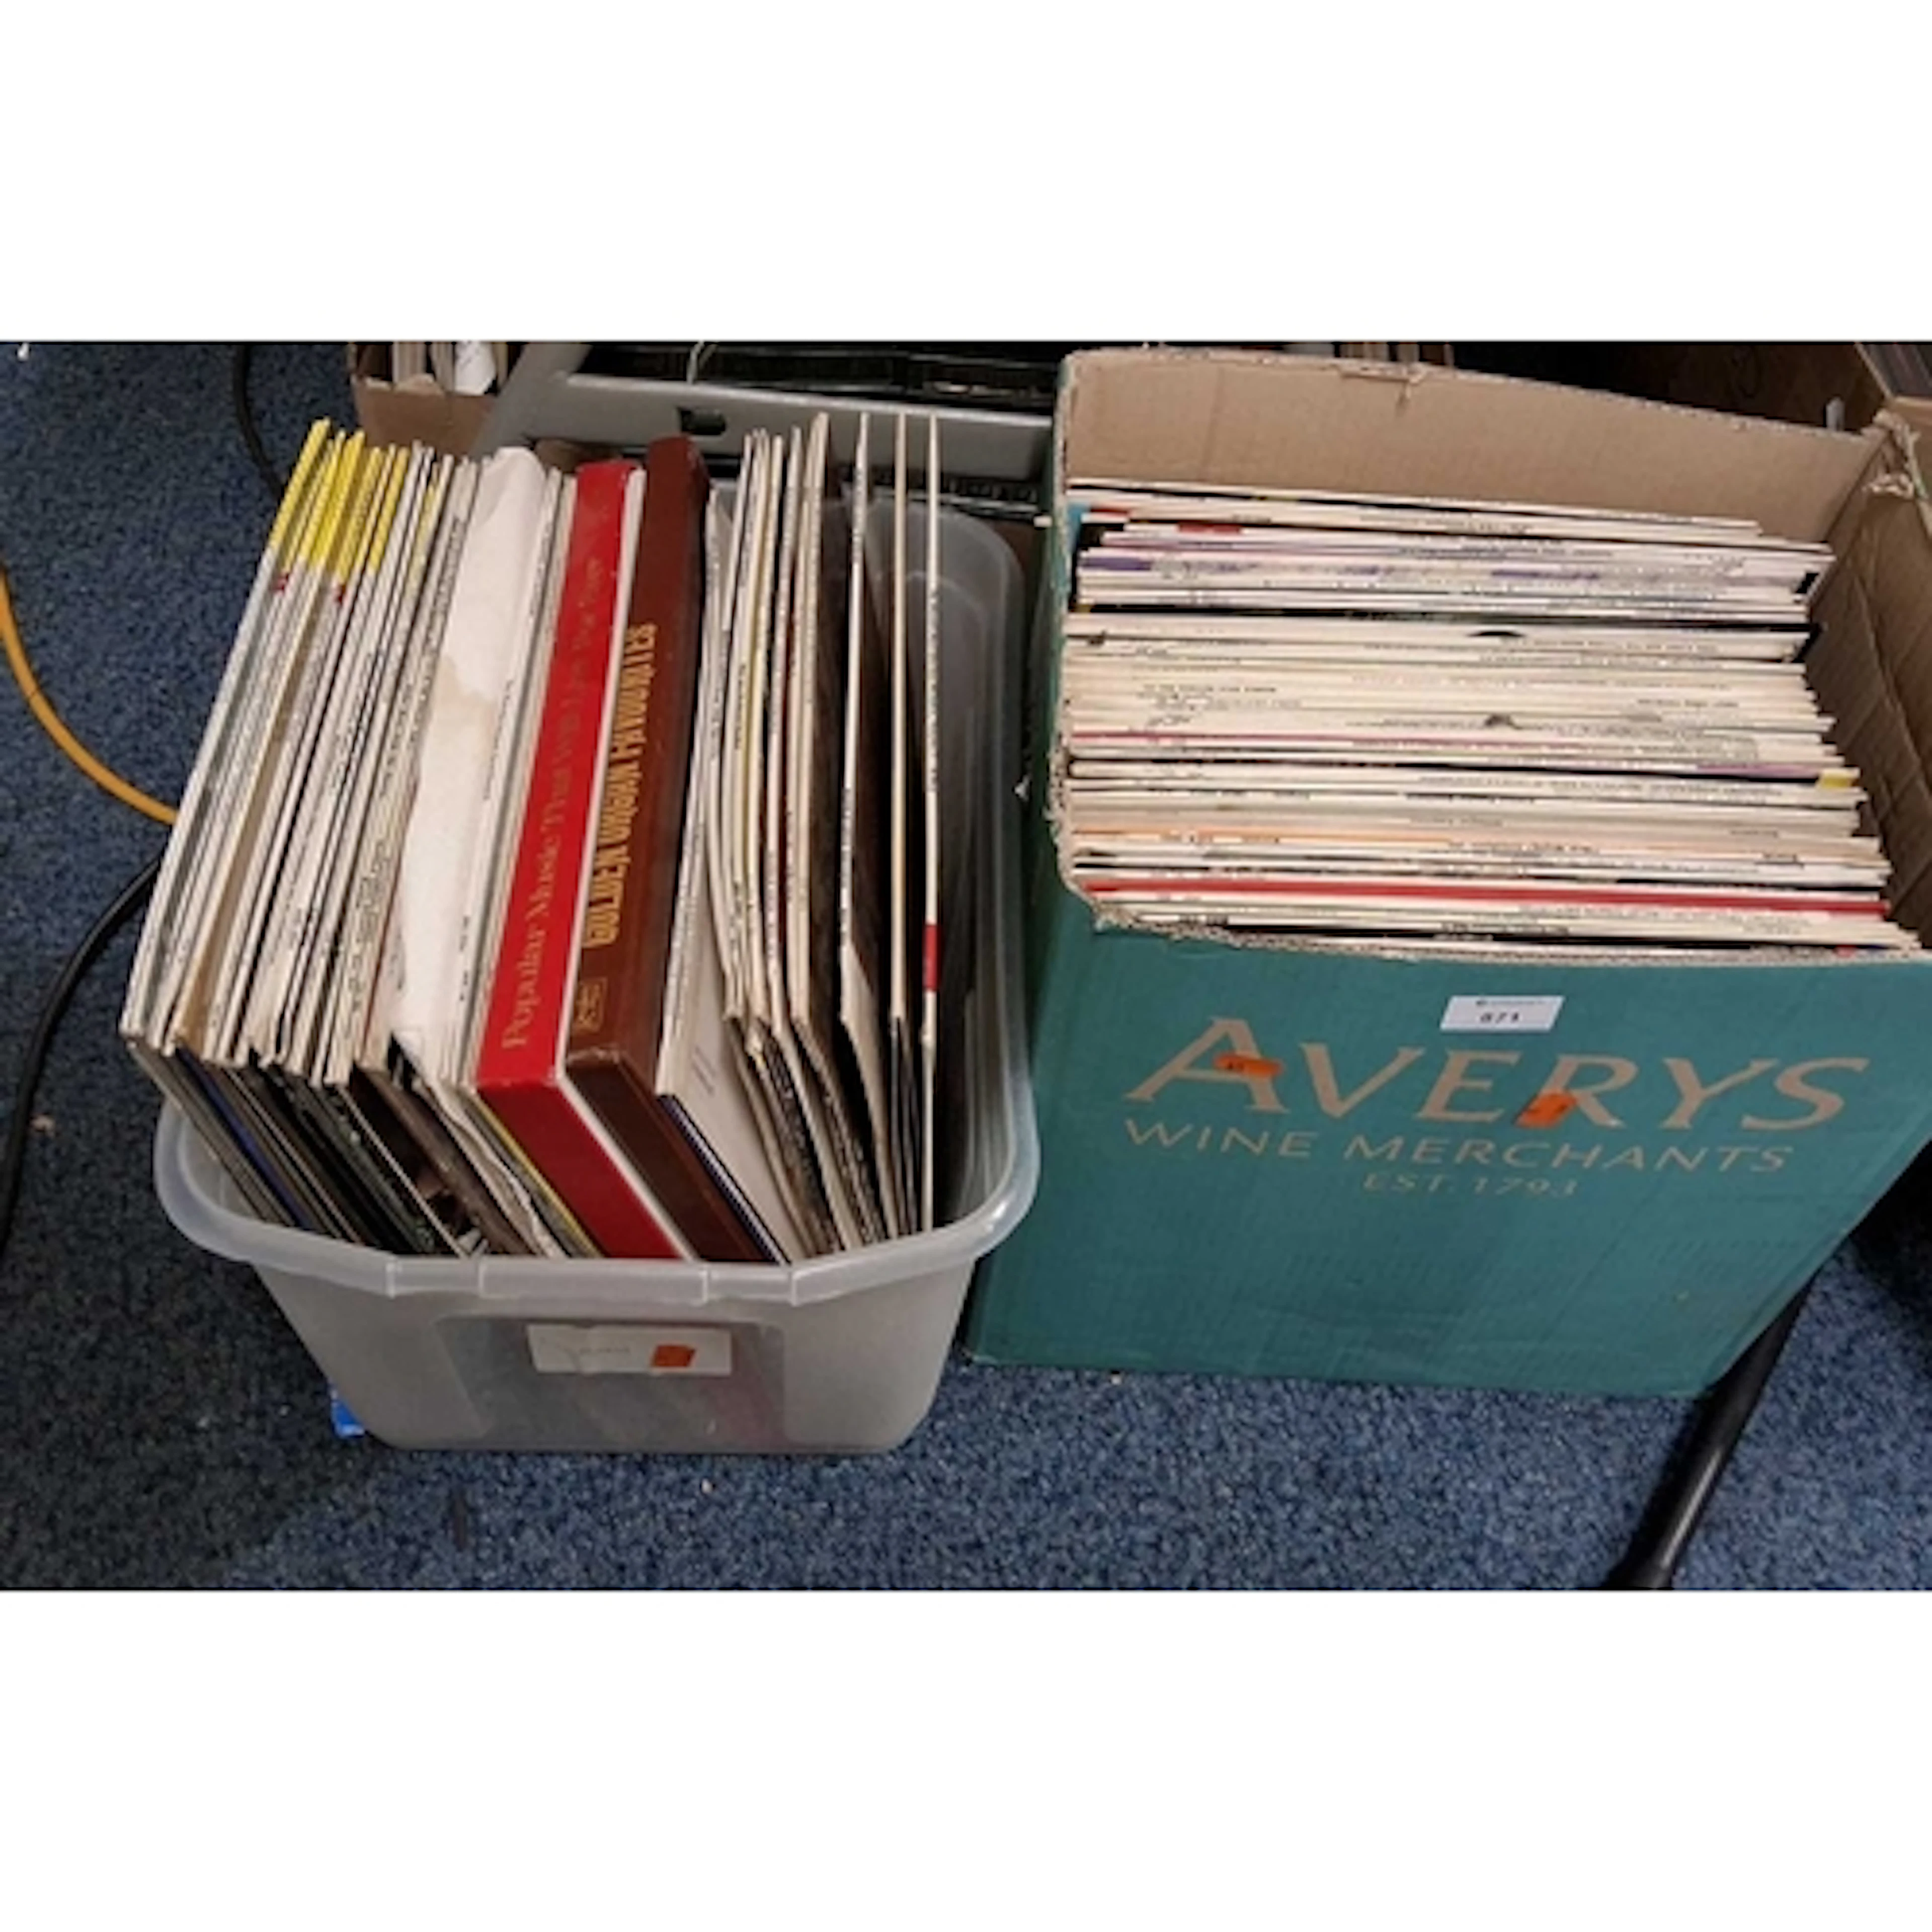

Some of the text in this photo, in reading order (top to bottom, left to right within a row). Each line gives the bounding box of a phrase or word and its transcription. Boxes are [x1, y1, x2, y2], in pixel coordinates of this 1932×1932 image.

[610, 624, 656, 757] FAVOURITES
[599, 763, 640, 842] ORGAN
[501, 927, 545, 1047] Popular
[526, 835, 561, 920] Music
[582, 846, 630, 947] GOLDEN
[1124, 1017, 1870, 1131] AVERYS
[1125, 1119, 1793, 1172] WINE MERCHANTS
